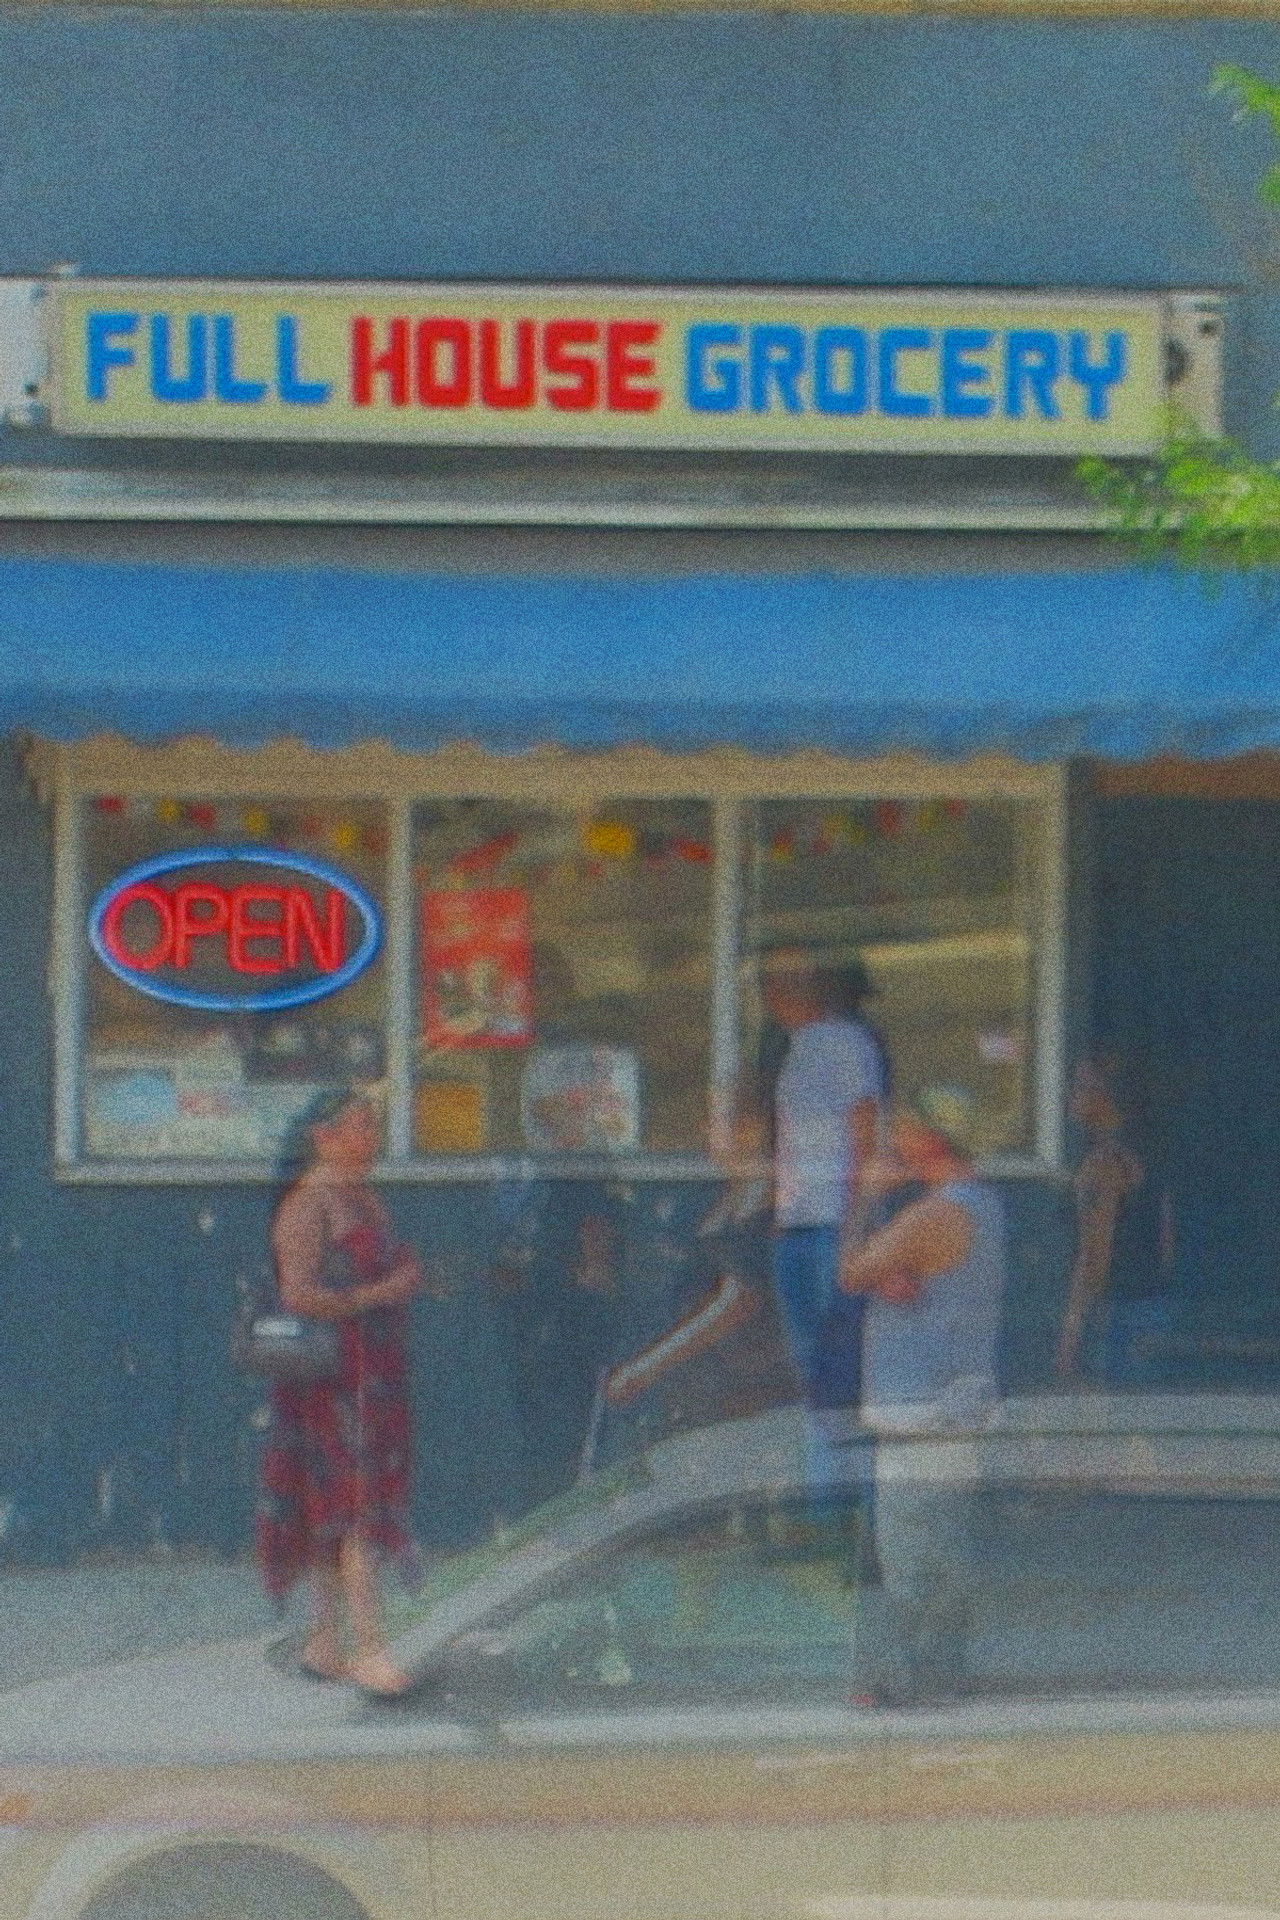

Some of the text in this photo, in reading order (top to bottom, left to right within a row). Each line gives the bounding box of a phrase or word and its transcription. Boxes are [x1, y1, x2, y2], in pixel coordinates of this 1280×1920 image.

[85, 312, 1127, 420] FULL HOUSE GROCERY
[103, 882, 346, 973] OPEN
